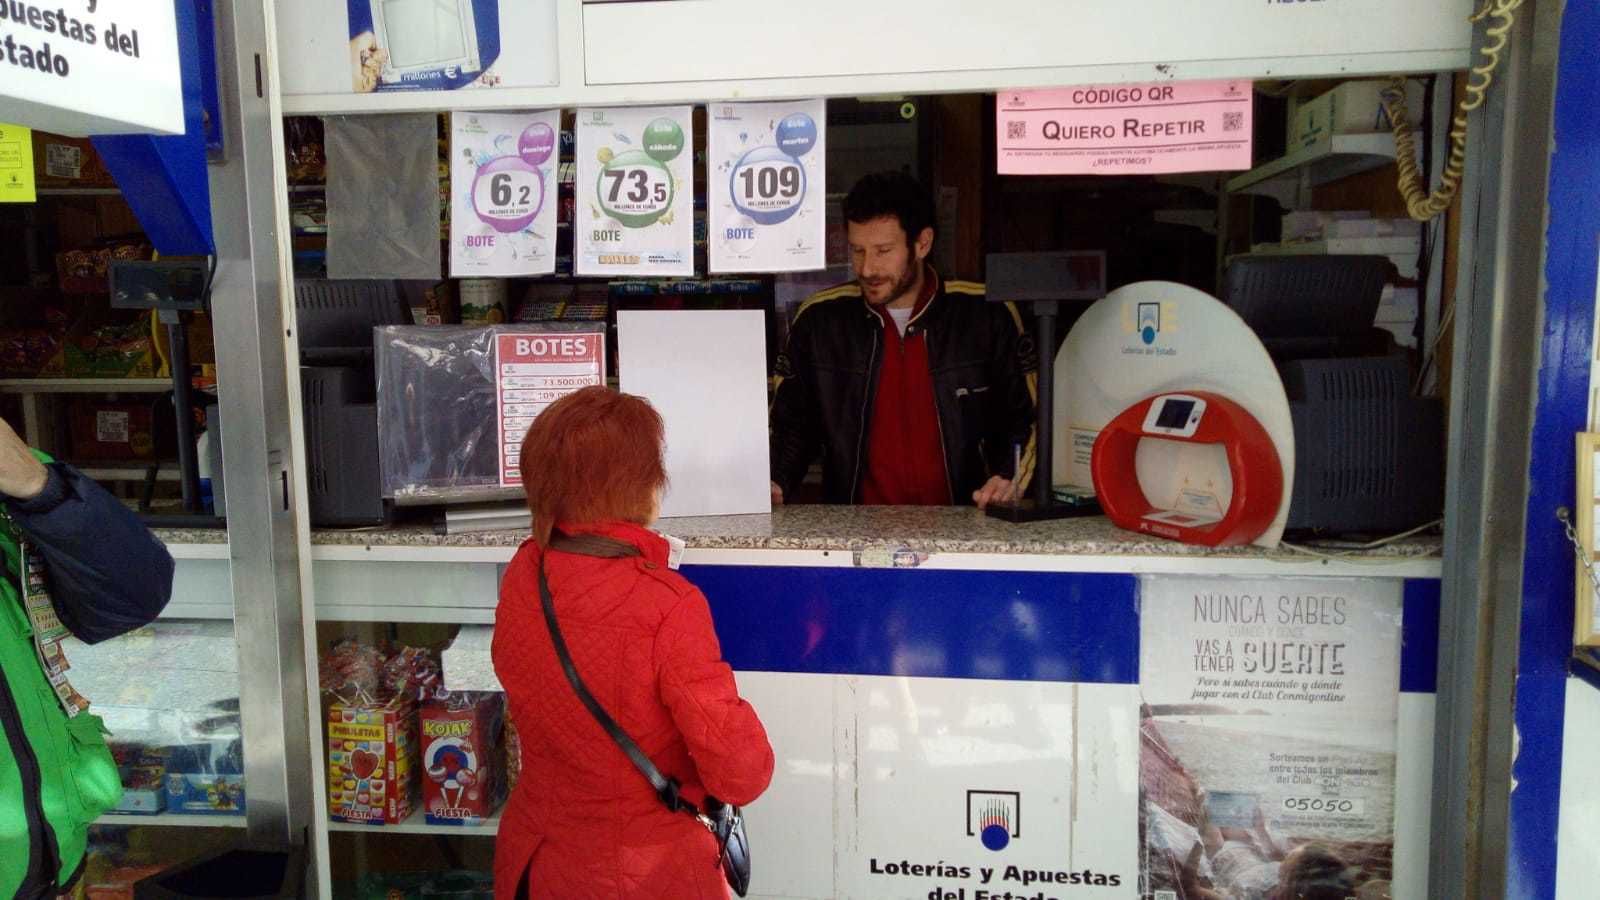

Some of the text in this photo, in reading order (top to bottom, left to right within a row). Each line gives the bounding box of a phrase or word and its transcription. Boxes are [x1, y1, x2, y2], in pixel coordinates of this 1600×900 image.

[104, 23, 140, 58] del
[1072, 86, 1174, 104] CÓDIGO QR
[1042, 118, 1205, 141] QUIERO REPETIR
[490, 173, 530, 207] 6,2
[604, 169, 667, 204] 73,5
[739, 166, 800, 198] 109
[466, 235, 496, 247] BOTE
[593, 230, 621, 241] BOTE
[726, 228, 754, 239] BOTE
[515, 338, 588, 356] BOTES
[1194, 594, 1346, 625] NUNCA SABES
[1195, 639, 1233, 655] VAS A
[1194, 655, 1234, 672] TENER
[1243, 641, 1346, 675] SUERTE
[1197, 676, 1219, 687] Pero
[1233, 677, 1260, 688] sabes
[1301, 681, 1309, 691] y
[1191, 690, 1220, 700] jugar
[1222, 691, 1240, 699] con
[1241, 690, 1250, 699] el
[1252, 690, 1274, 700] Club
[423, 719, 473, 737] KOJAK
[1269, 765, 1292, 773] entre
[1293, 775, 1312, 785] Club
[1284, 798, 1353, 812] 05050
[341, 807, 373, 821] FIESTA
[433, 807, 472, 820] FIESTA
[870, 858, 1121, 887] Loterías y Apuestas
[928, 887, 965, 900] del
